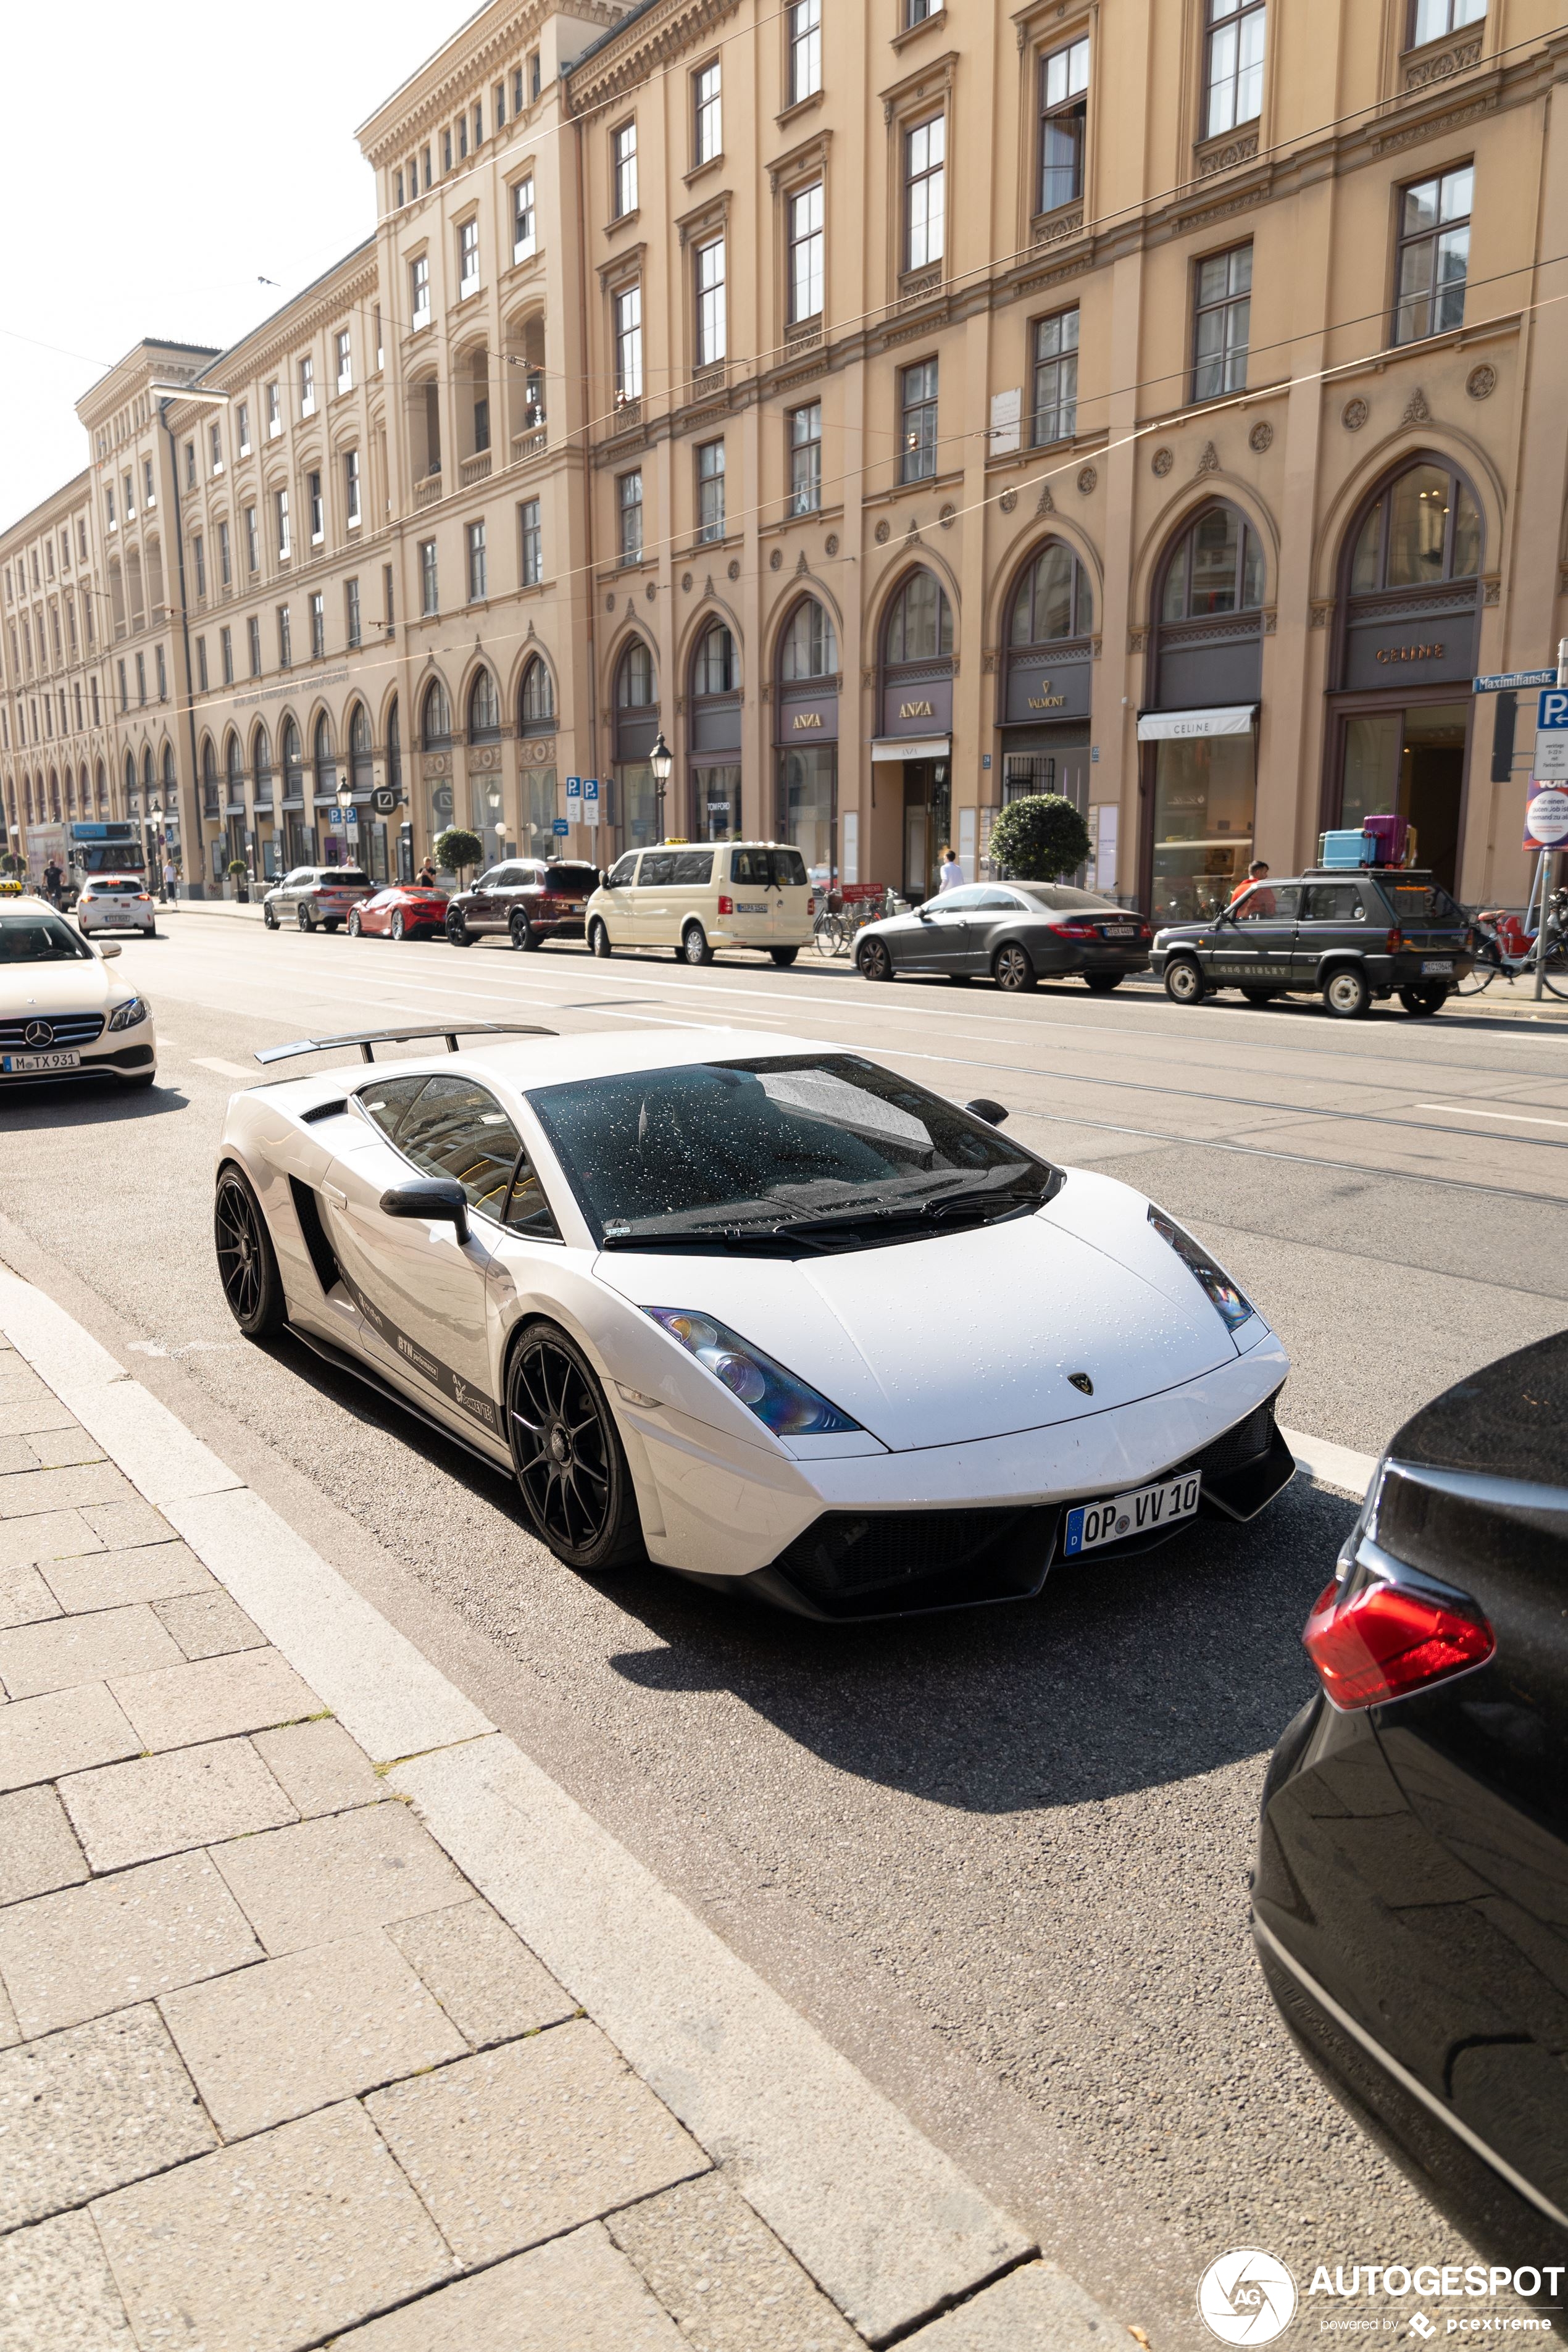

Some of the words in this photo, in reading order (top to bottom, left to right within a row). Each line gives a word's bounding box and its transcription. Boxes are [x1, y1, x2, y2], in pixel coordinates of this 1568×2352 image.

[1376, 643, 1443, 664] CELINE
[1479, 672, 1551, 690] Maximilianstr.
[1028, 696, 1064, 708] VALMONT
[1543, 694, 1567, 725] P
[1174, 723, 1209, 734] CELINE
[717, 802, 730, 810] FORD
[864, 885, 882, 893] RIEDER
[16, 1057, 25, 1069] M
[33, 1056, 50, 1068] TX
[52, 1054, 75, 1066] 931
[1085, 1505, 1117, 1542] OP
[1136, 1489, 1164, 1527] VV
[1169, 1479, 1198, 1516] 10
